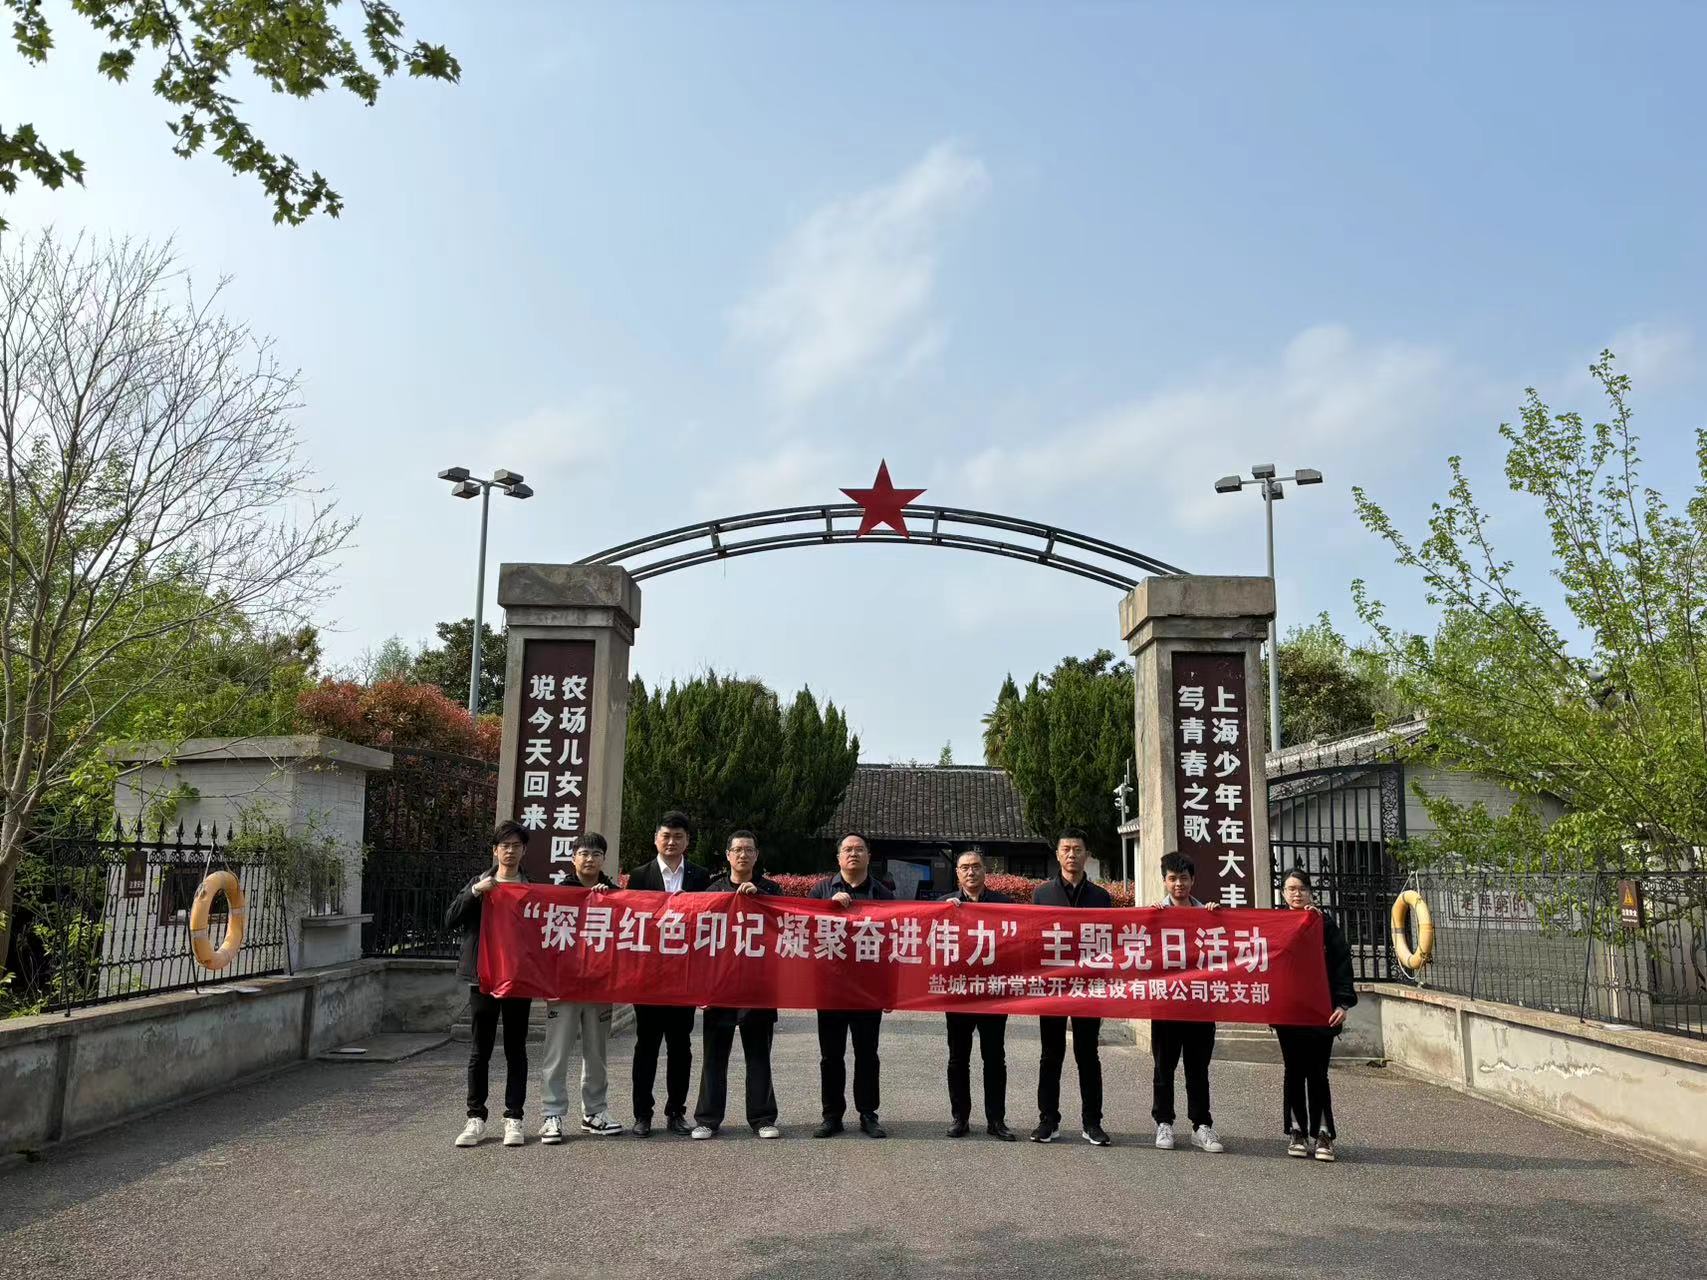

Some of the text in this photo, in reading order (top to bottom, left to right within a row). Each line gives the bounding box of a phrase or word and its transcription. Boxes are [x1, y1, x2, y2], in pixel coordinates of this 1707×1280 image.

[520, 674, 555, 831] 说今天回来
[1178, 685, 1212, 844] 写青春之歌
[1210, 685, 1248, 909] 上海少年在大丰
[927, 973, 1271, 1005] 盐城市新常盐开发建设有限公司党支部
